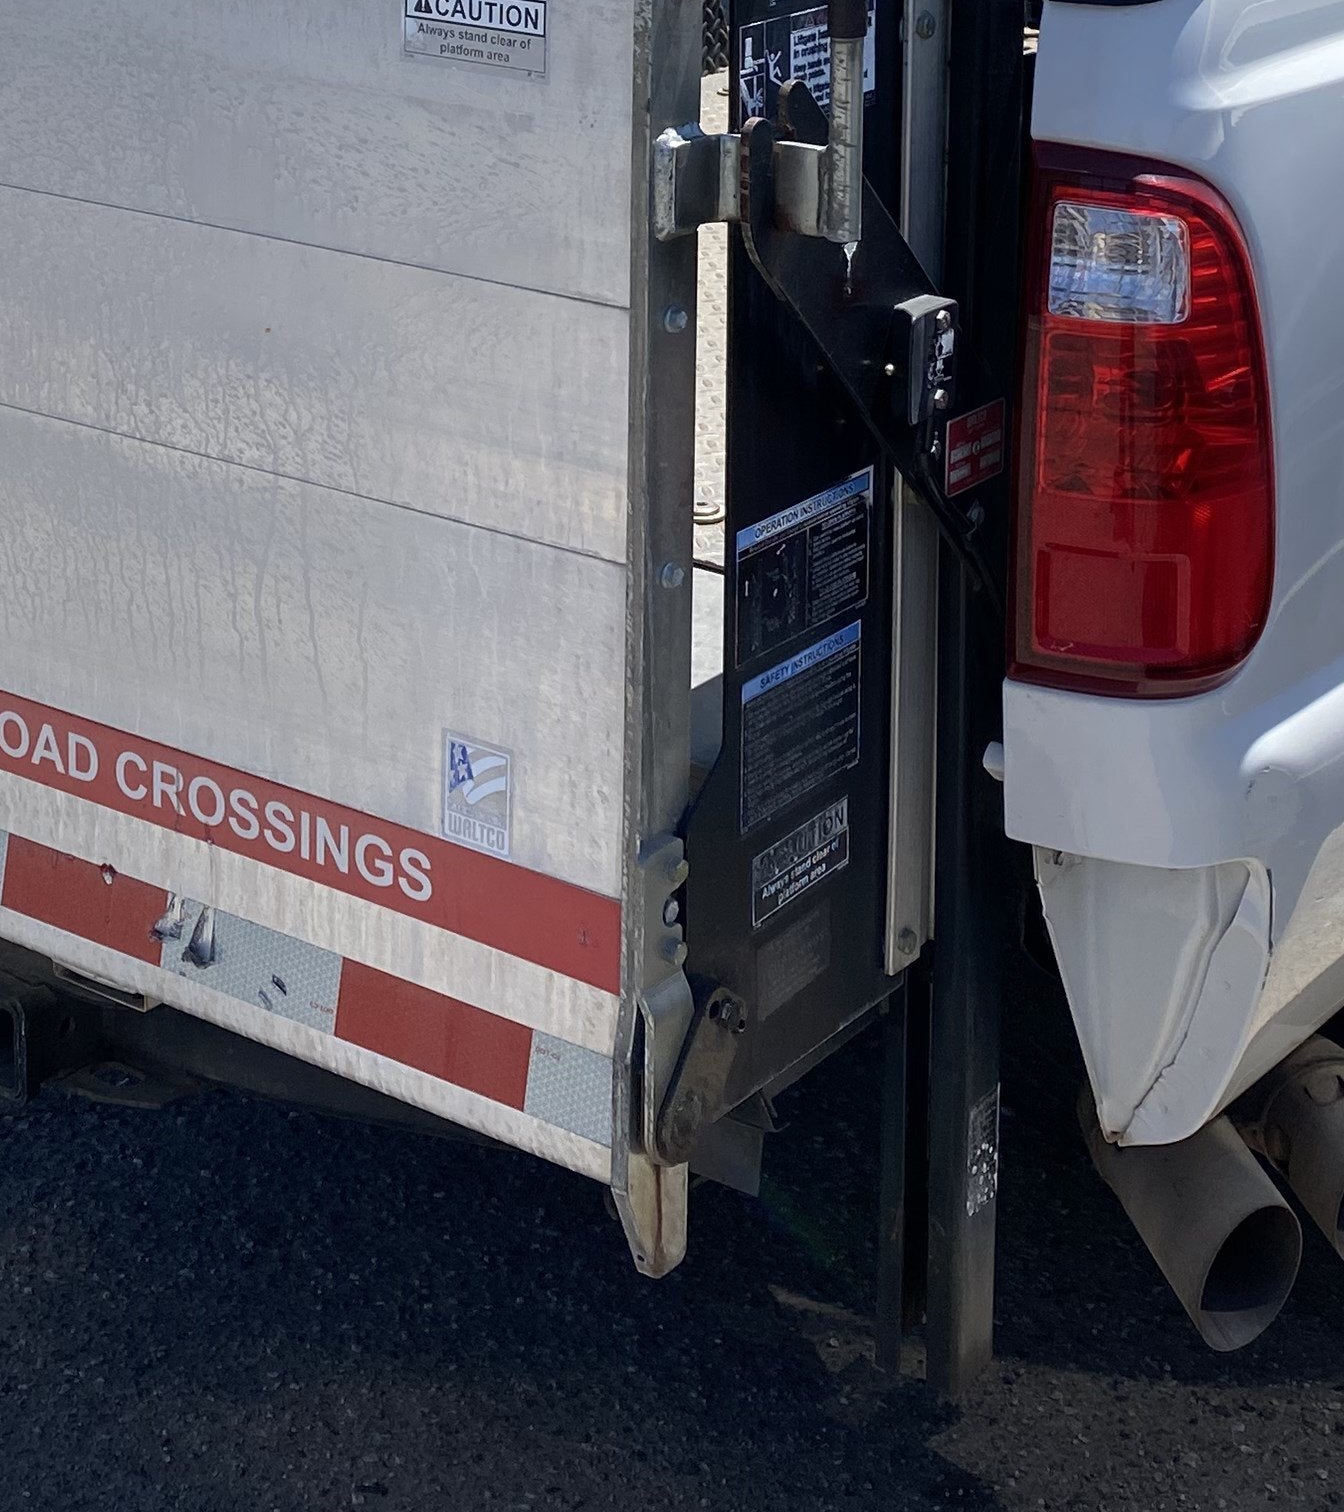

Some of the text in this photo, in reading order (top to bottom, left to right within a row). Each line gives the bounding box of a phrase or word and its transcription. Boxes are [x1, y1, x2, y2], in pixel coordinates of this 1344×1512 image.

[417, 22, 531, 50] Always stand clear of
[440, 43, 510, 63] platform area
[754, 511, 799, 540] OPERATION
[759, 635, 845, 690] SAFETY INSTRUCTIONS
[115, 751, 434, 903] CROSSINGS
[448, 812, 505, 851] WALTCO
